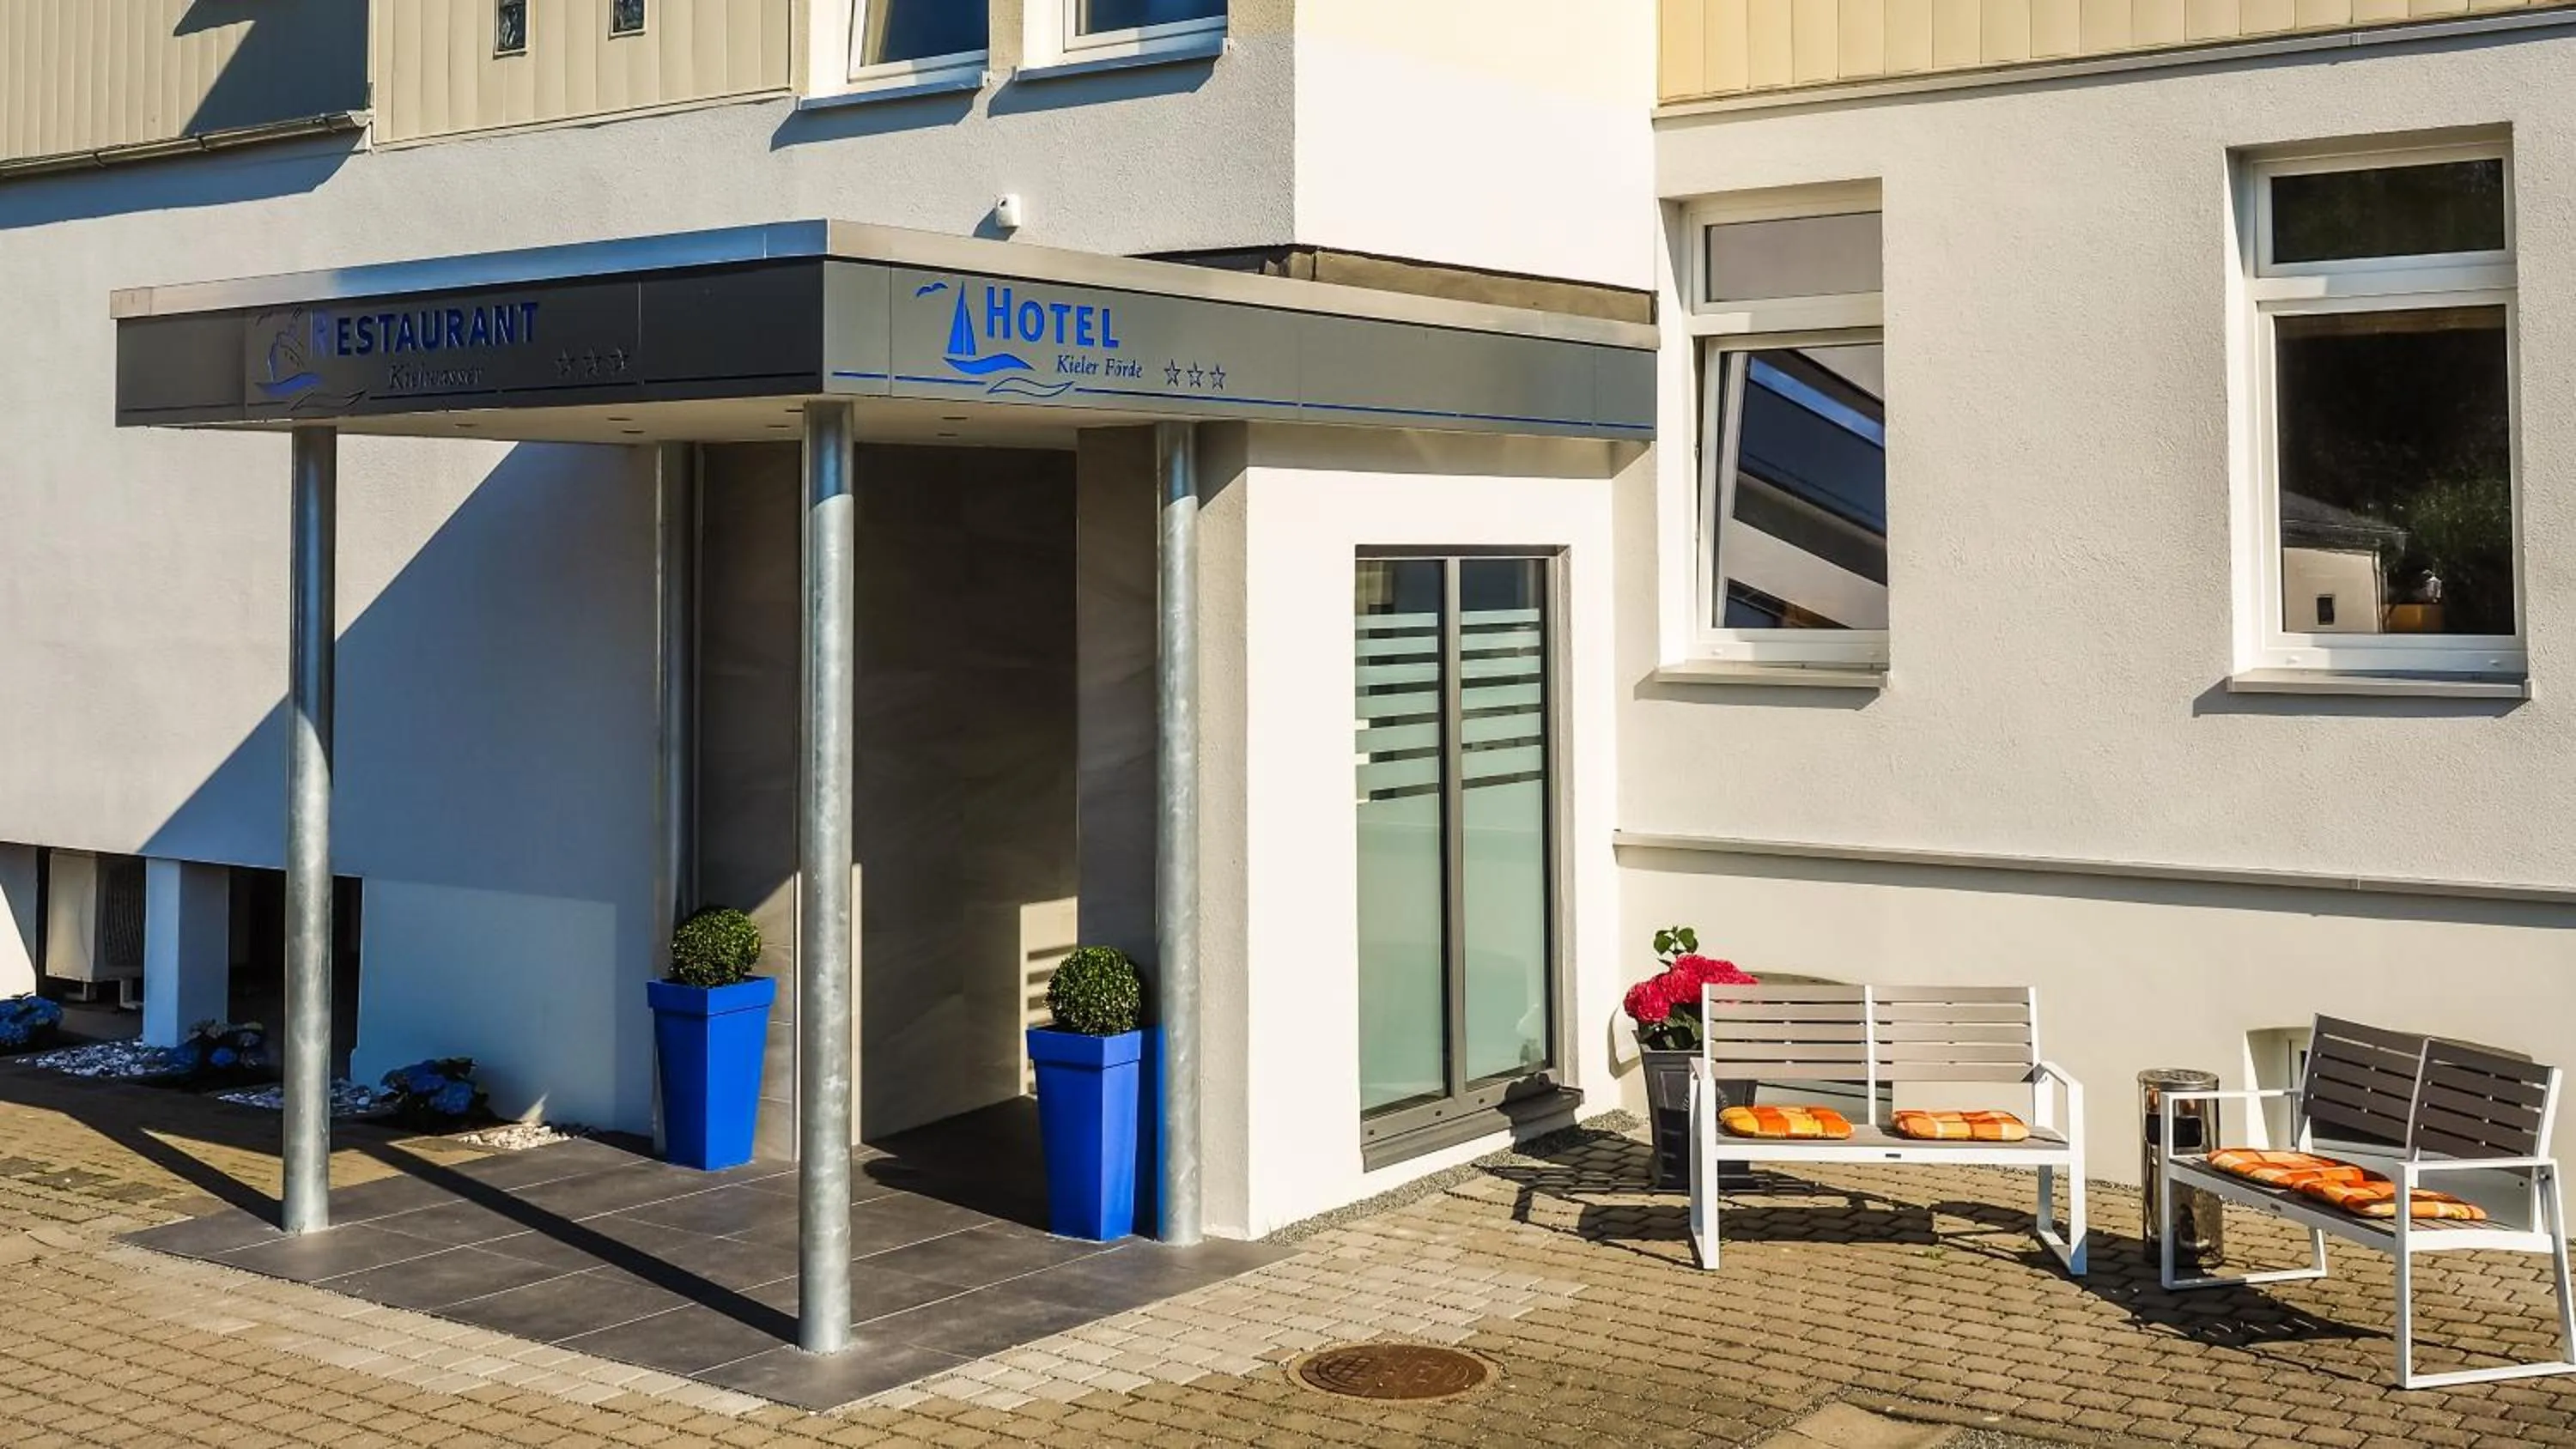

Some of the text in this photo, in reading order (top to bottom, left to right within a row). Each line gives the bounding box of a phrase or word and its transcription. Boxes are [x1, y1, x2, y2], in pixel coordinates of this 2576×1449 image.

[312, 303, 539, 356] RESTAURANT
[987, 286, 1120, 349] HOTEL
[1057, 355, 1144, 379] Kieler Förde
